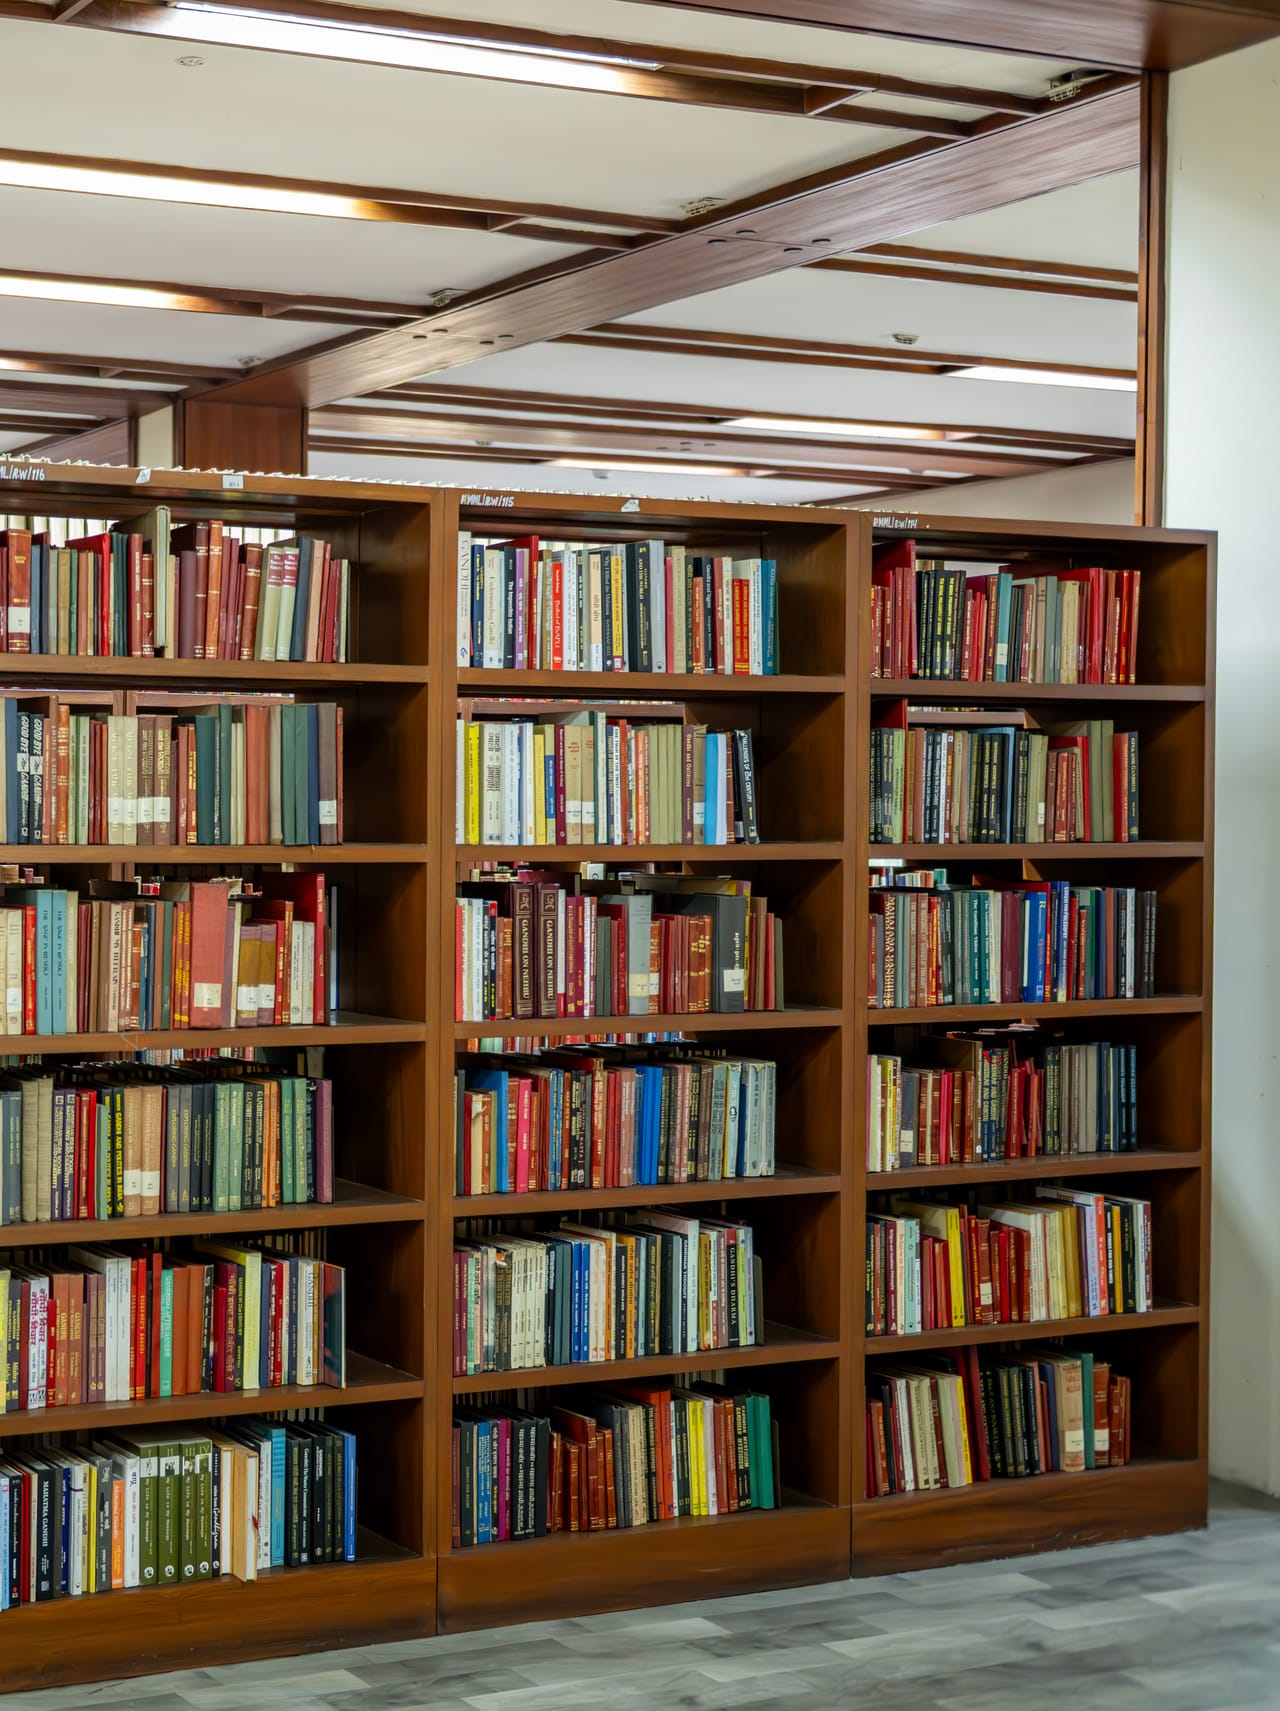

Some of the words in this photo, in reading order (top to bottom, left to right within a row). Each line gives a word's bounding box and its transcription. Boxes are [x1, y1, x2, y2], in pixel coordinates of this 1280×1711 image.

[460, 539, 470, 590] GANDHI
[21, 715, 29, 737] GOOD
[34, 718, 42, 740] GOOD
[20, 737, 29, 753] BYE
[33, 740, 42, 755] BYE
[546, 920, 554, 955] GANDHI
[522, 954, 529, 967] ON
[546, 956, 554, 968] ON
[522, 968, 530, 999] NEHRU
[546, 969, 554, 1000] NEHRU
[307, 1272, 315, 1308] GANDHI
[144, 1478, 150, 1486] My
[165, 1477, 171, 1485] My
[185, 1476, 191, 1484] My
[42, 1480, 50, 1518] MAHATMA
[144, 1511, 150, 1519] My
[165, 1509, 171, 1517] My
[185, 1508, 191, 1517] My
[199, 1505, 206, 1514] My
